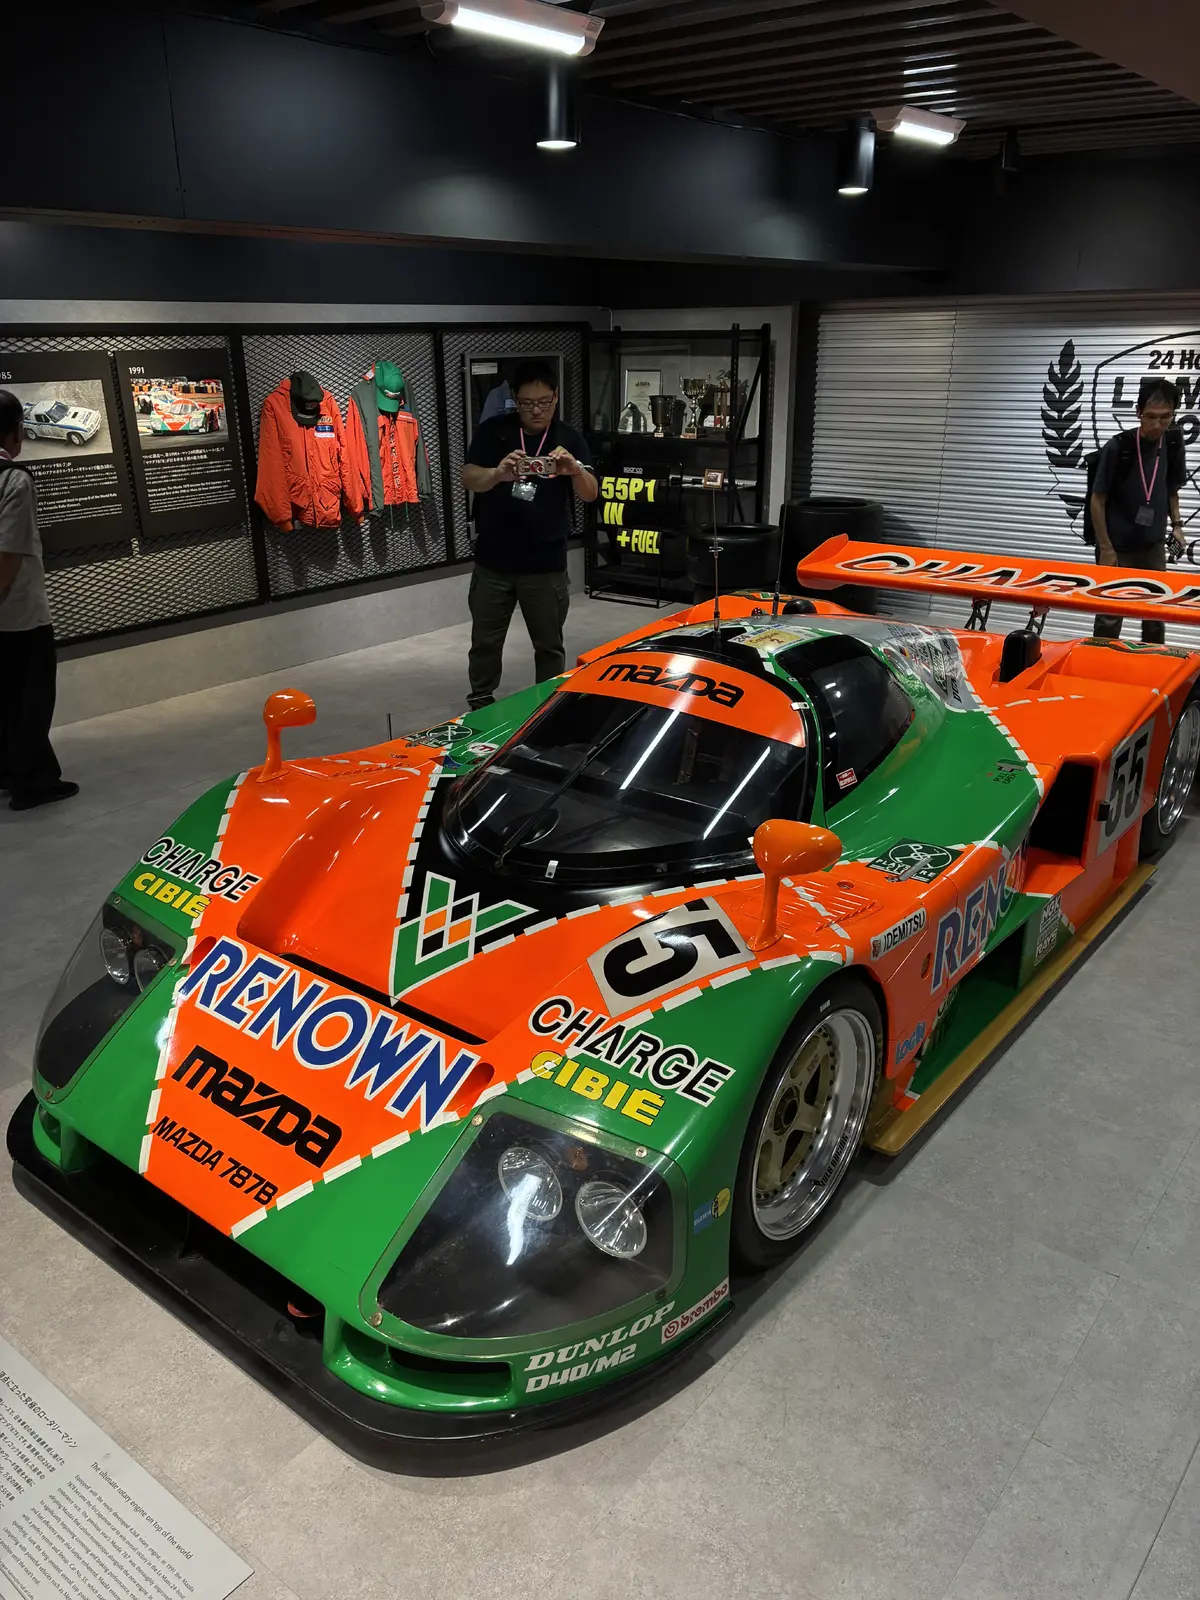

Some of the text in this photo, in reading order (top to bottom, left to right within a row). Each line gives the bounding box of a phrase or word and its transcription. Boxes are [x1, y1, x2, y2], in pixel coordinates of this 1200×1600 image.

[128, 366, 145, 375] 1991
[1148, 350, 1175, 370] 24
[601, 477, 657, 502] 55P1
[603, 502, 625, 526] IN
[597, 664, 745, 708] mazda
[1105, 731, 1149, 837] 55
[140, 836, 264, 904] CHARGE
[883, 910, 927, 951] IDEMITSU
[173, 935, 481, 1134] RENOWN
[528, 995, 737, 1108] CHARGE
[171, 1044, 343, 1169] mazda
[151, 1116, 280, 1206] MAZDA 787B
[680, 1283, 728, 1329] brembo
[523, 1300, 676, 1372] DUNLOP
[90, 1461, 100, 1472] The
[98, 1470, 118, 1489] ultimate
[116, 1488, 131, 1502] rotary
[130, 1501, 147, 1517] engine
[145, 1515, 154, 1524] on
[152, 1521, 162, 1532] top
[166, 1535, 177, 1545] the
[176, 1544, 193, 1559] world
[110, 1540, 122, 1553] Mazda
[98, 1576, 110, 1590] Mazda
[166, 1563, 176, 1573] 1991
[182, 1578, 194, 1592] Mazda
